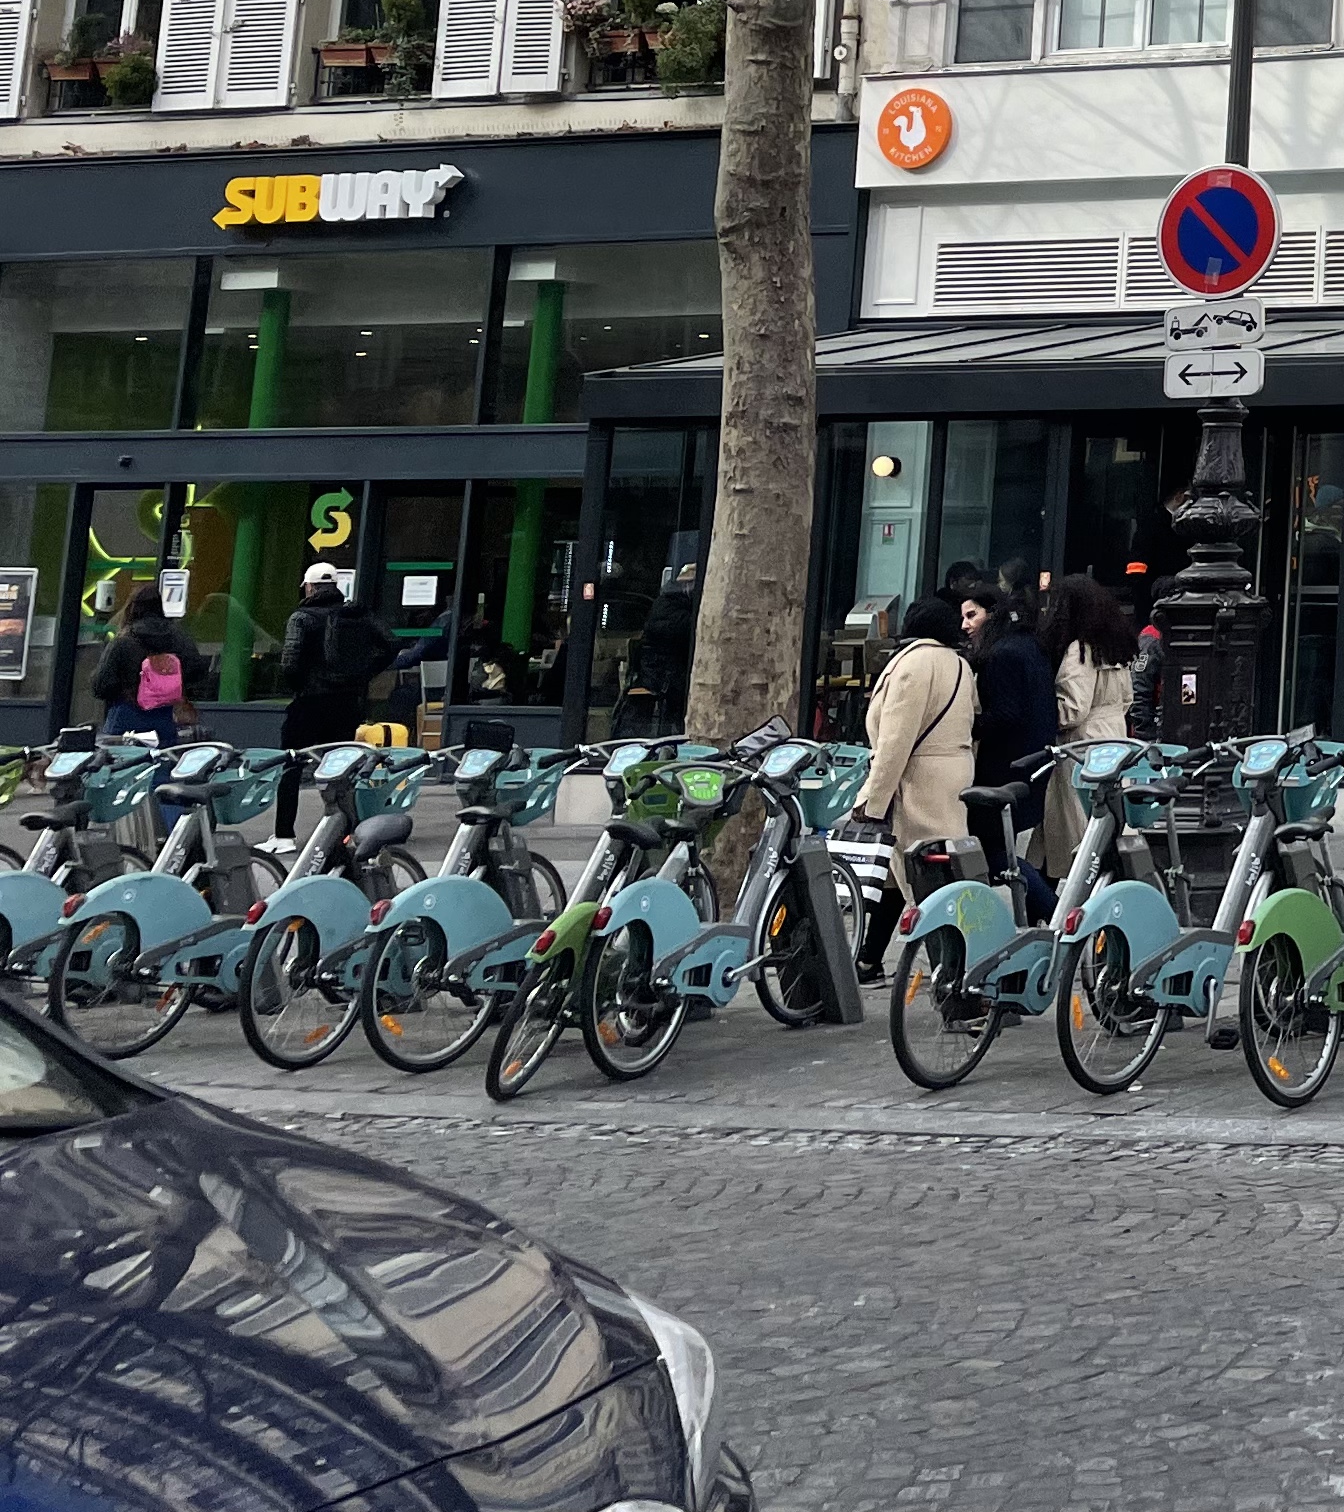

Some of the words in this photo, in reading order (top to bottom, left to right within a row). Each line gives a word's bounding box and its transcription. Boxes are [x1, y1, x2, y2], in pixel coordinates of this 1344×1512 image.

[888, 94, 938, 114] LOUISIANA
[889, 145, 933, 163] KITCHEN
[212, 164, 465, 231] SUBWAY
